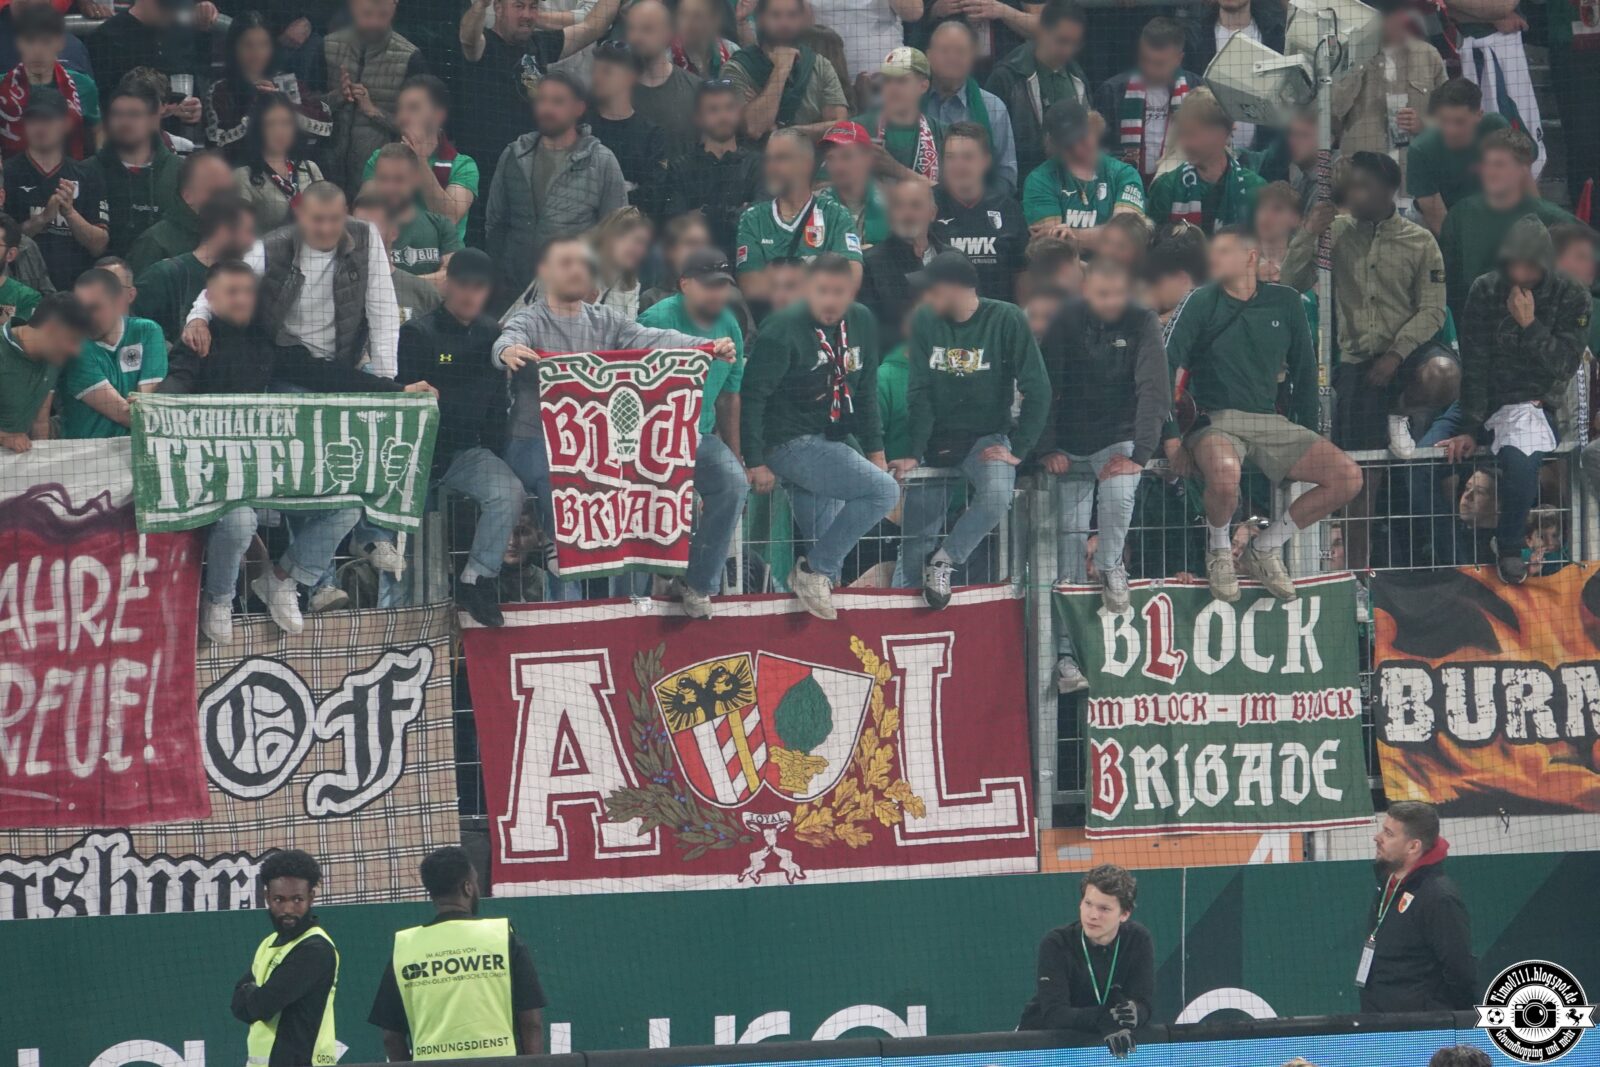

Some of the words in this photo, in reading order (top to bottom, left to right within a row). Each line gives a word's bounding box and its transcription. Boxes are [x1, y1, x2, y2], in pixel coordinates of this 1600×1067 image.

[950, 236, 997, 255] WWK
[144, 402, 299, 437] DURCHHALTEN
[147, 436, 304, 509] TETE!
[1100, 591, 1324, 685] BLOCK
[1133, 693, 1208, 724] BLOCK
[1090, 737, 1343, 821] BRIGADE
[750, 813, 786, 824] LOYAL
[431, 954, 505, 977] POWER
[416, 1036, 509, 1056] ORDNUNGSDIENST
